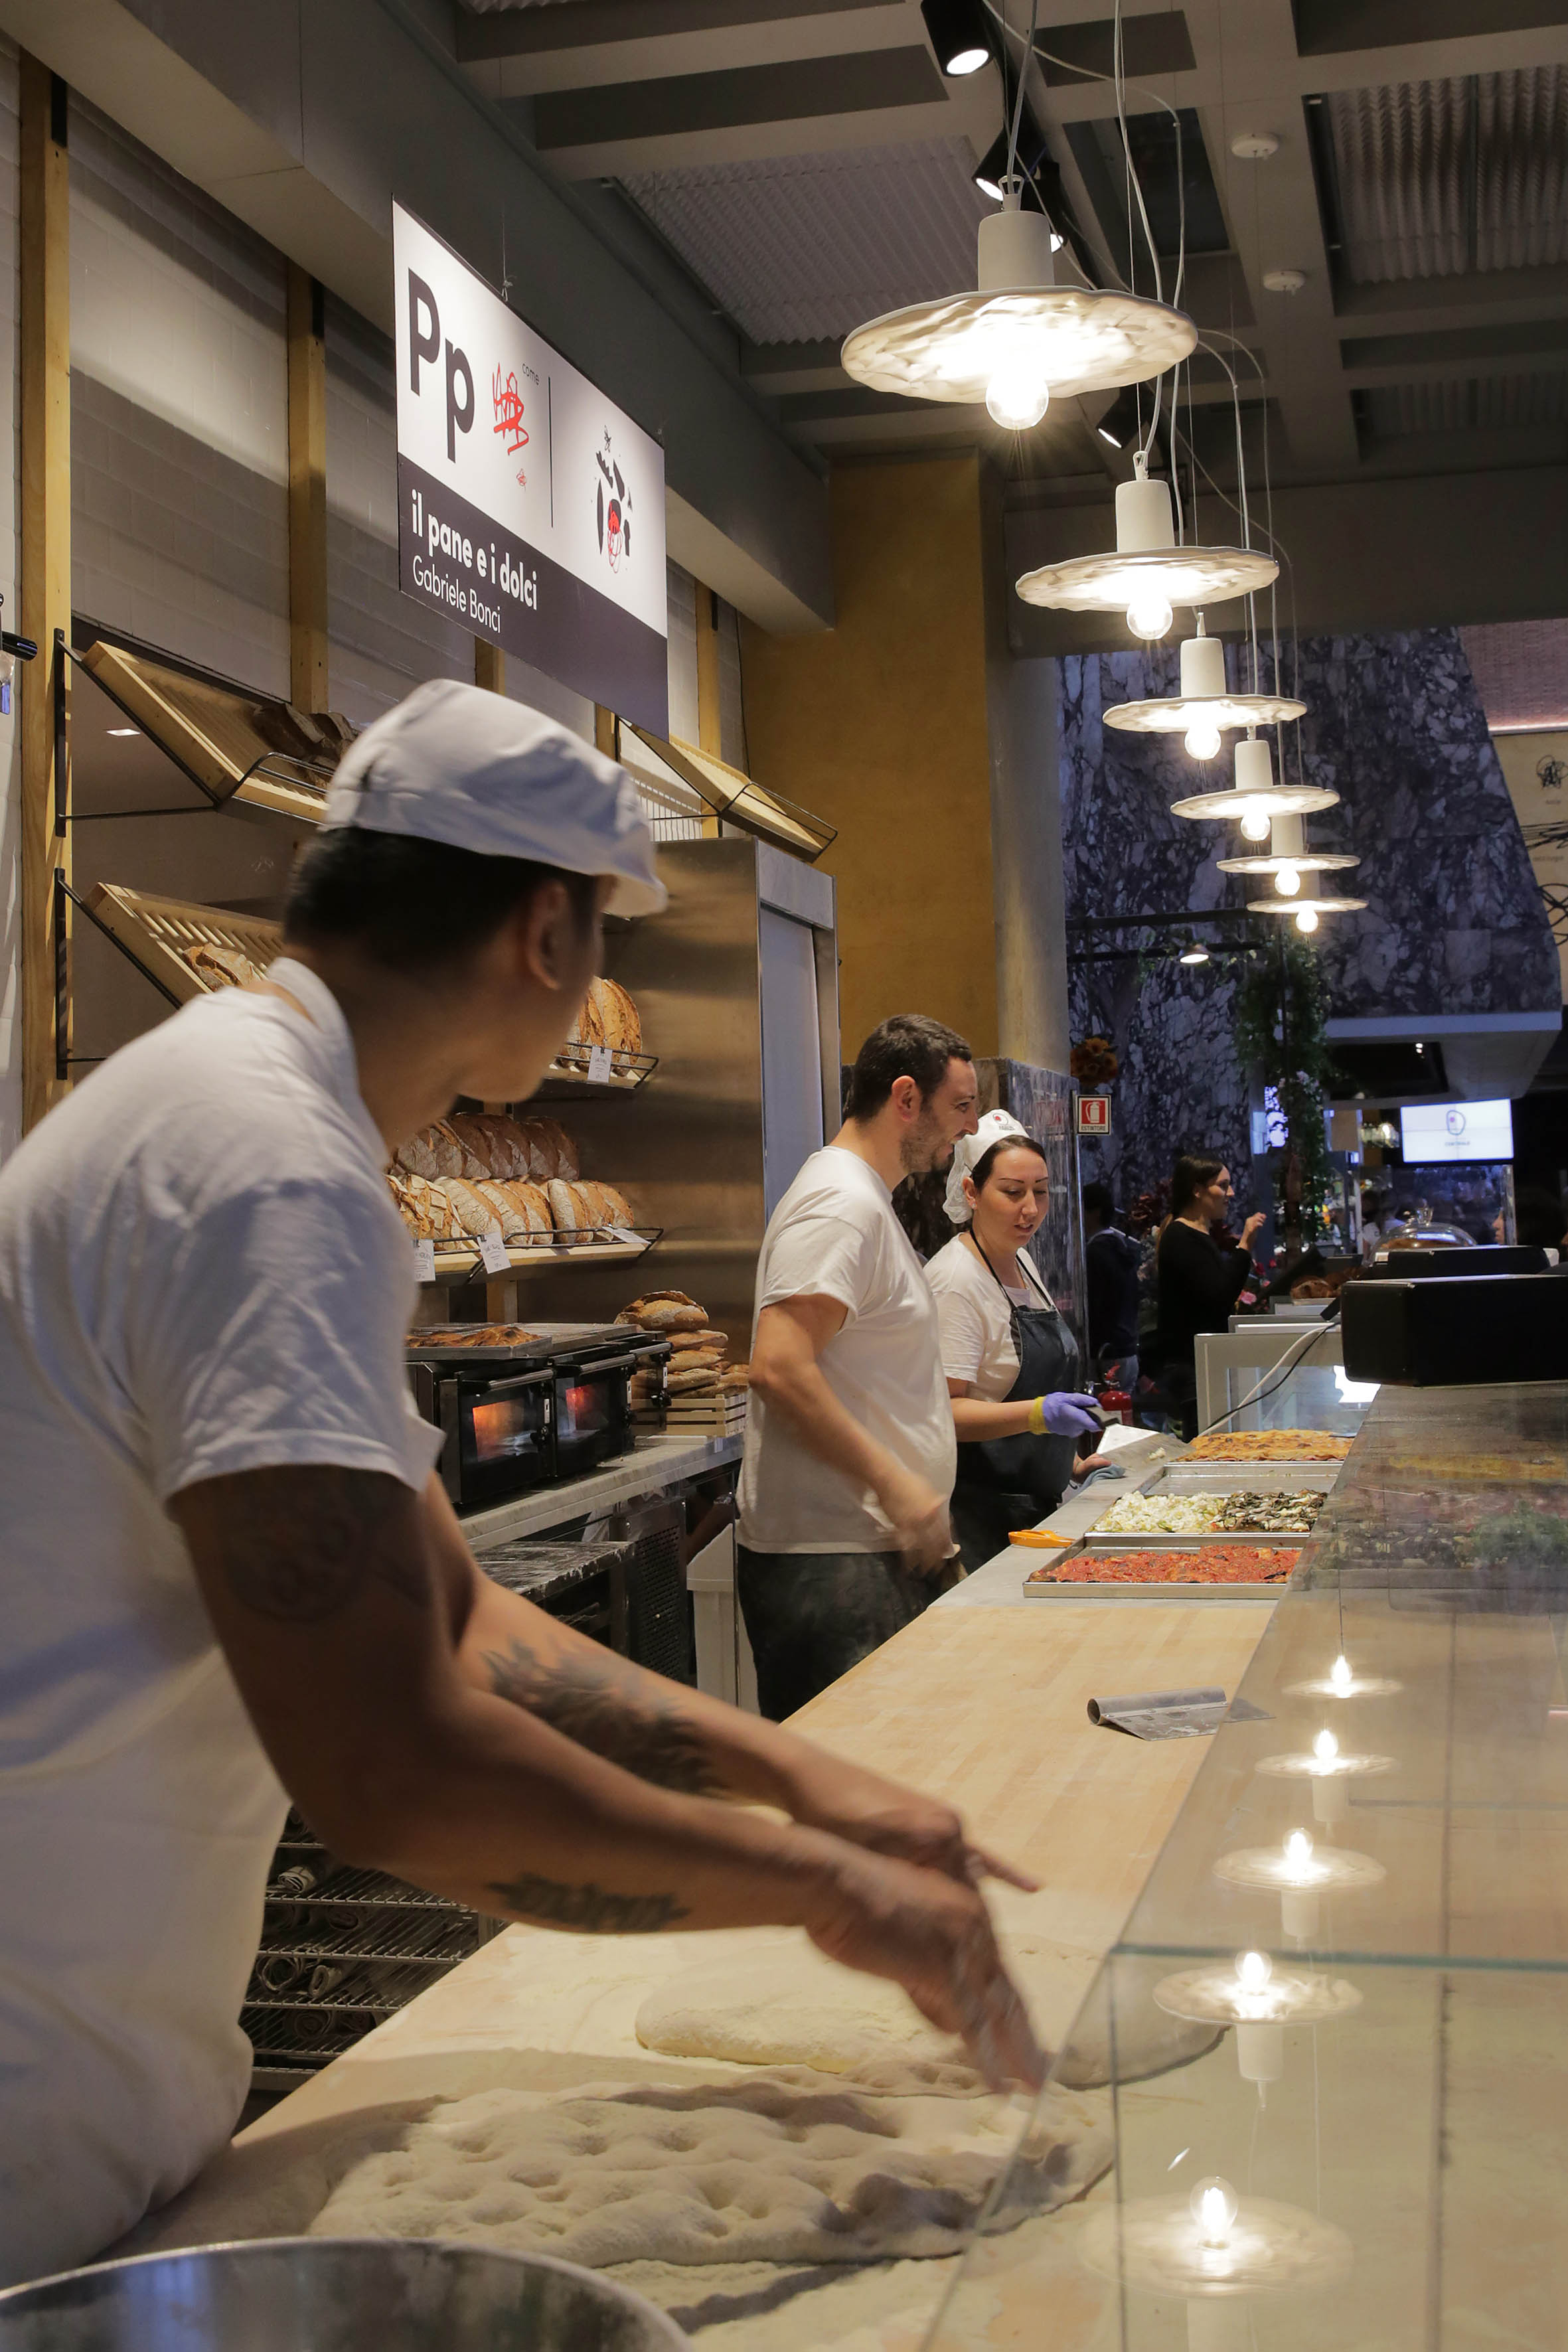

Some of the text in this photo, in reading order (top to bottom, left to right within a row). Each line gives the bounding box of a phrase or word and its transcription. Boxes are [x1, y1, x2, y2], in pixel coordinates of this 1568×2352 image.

[408, 268, 475, 463] Pp
[522, 363, 540, 386] come
[412, 489, 537, 611] il pane e i dolci
[413, 555, 501, 633] Gabriele Bonci
